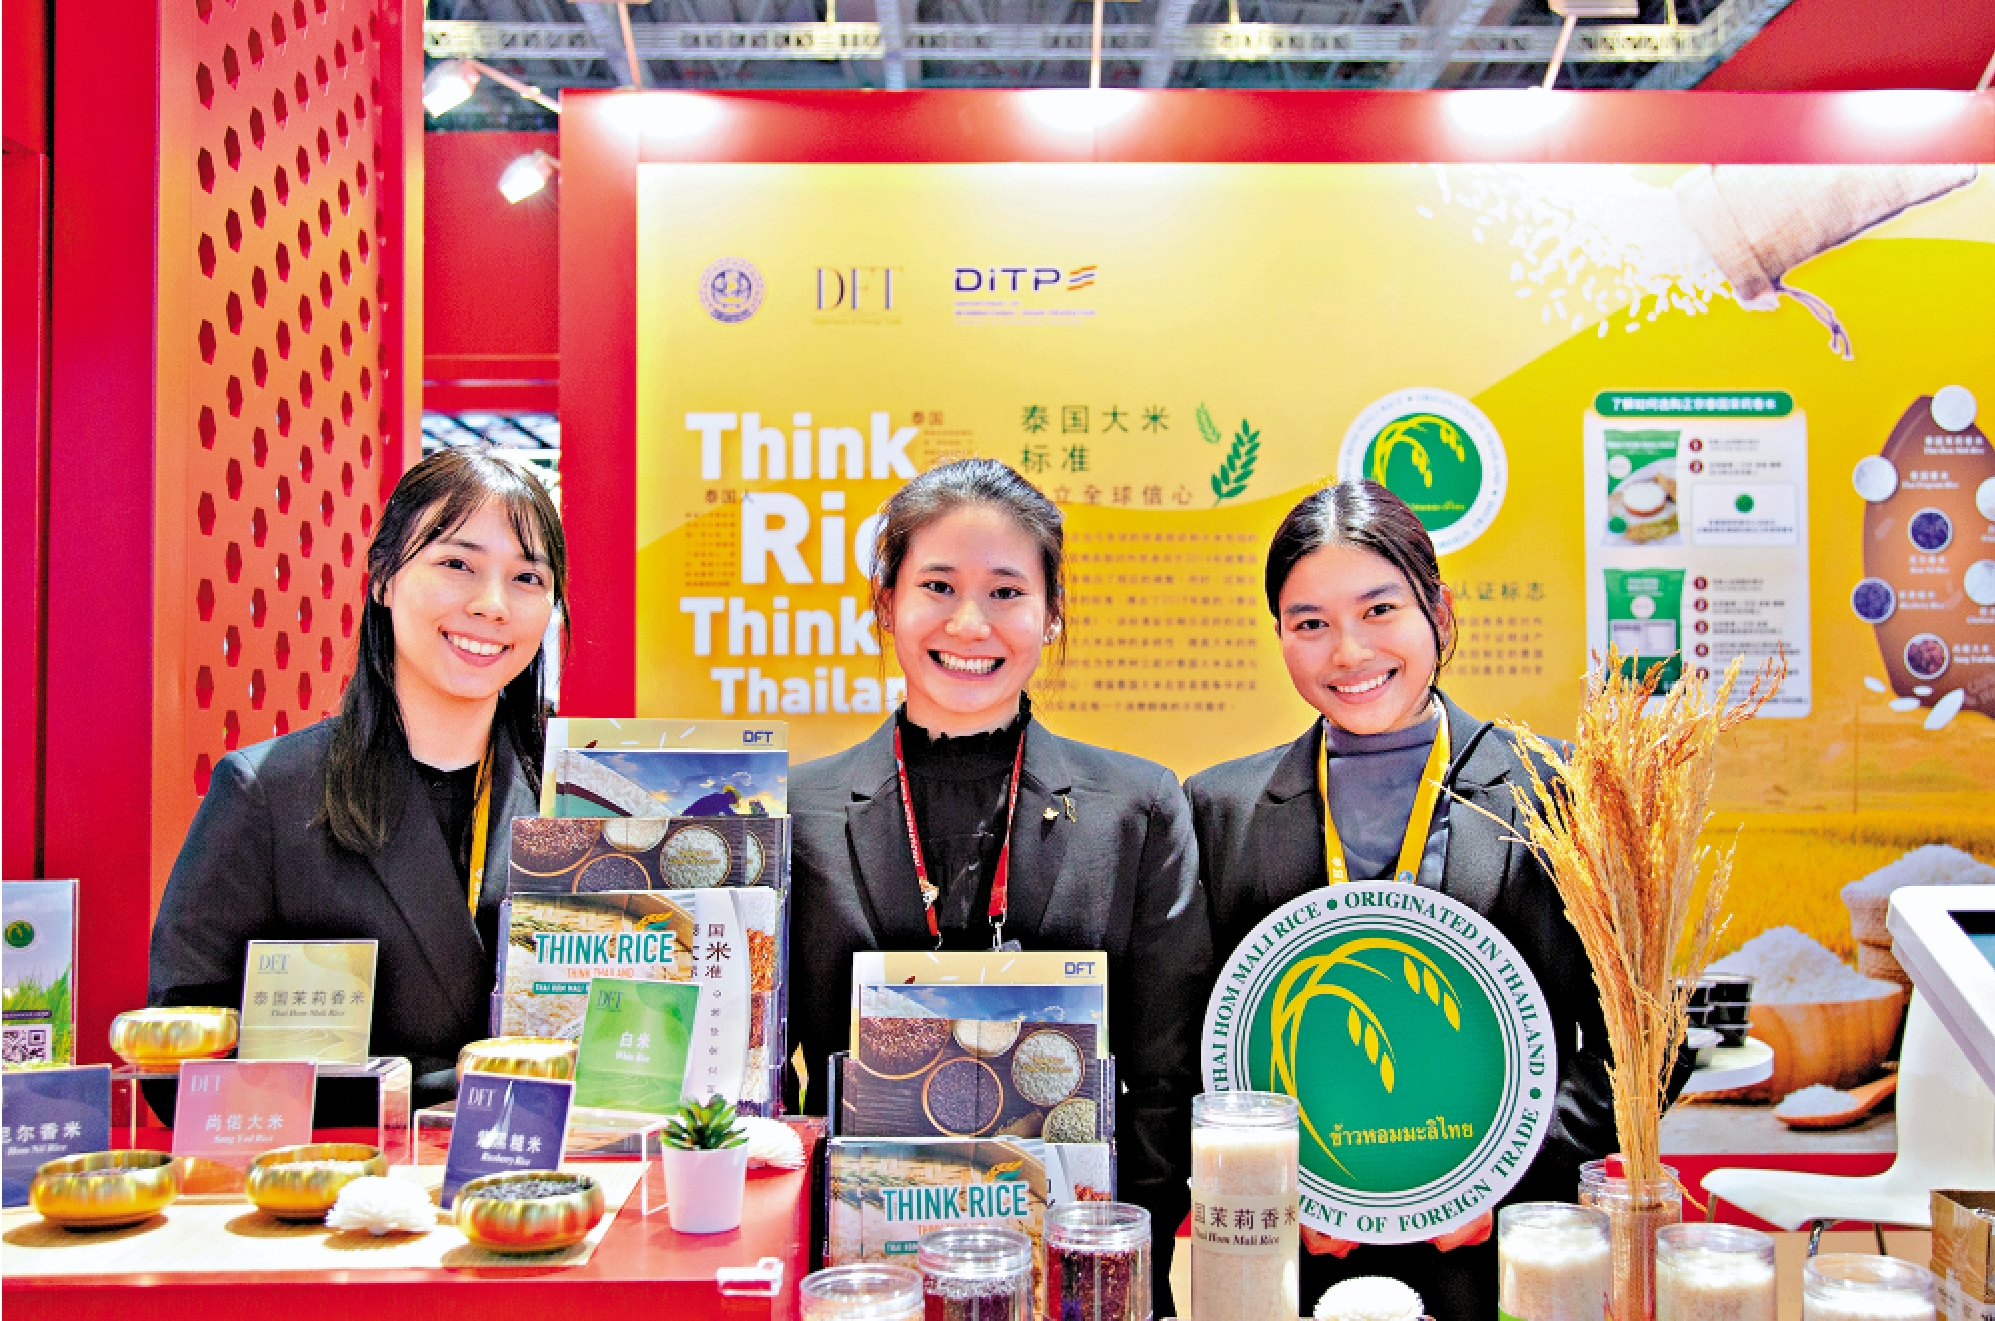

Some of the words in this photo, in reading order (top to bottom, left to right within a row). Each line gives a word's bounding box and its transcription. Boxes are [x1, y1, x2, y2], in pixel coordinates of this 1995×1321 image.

[813, 266, 902, 310] DFT
[1021, 405, 1169, 434] 泰国大米
[685, 411, 919, 480] Think
[1020, 444, 1090, 473] 标准
[1039, 484, 1194, 506] 立全球信心
[740, 490, 884, 583] Ri
[680, 596, 881, 656] Think
[711, 667, 907, 714] Thailan
[742, 730, 774, 743] DFT
[536, 932, 609, 965] THINK
[617, 932, 674, 964] RICE
[567, 967, 591, 978] THINK
[1064, 961, 1096, 976] DFT
[1212, 986, 1241, 1039] HOM
[1240, 935, 1276, 986] MALI
[1271, 901, 1323, 940] RICE
[1344, 891, 1478, 940] ORIGINATED
[1476, 935, 1502, 961] IN
[1497, 959, 1546, 1076] THAILAND
[619, 1031, 651, 1049] 白米
[1329, 1115, 1474, 1146] ข้าวหอมมะลิไทย
[1356, 1216, 1387, 1233] OF
[1399, 1179, 1492, 1233] FOREIGN
[1491, 1108, 1538, 1178] TRADE
[883, 1189, 961, 1222] THINK
[969, 1183, 1028, 1219] RICE
